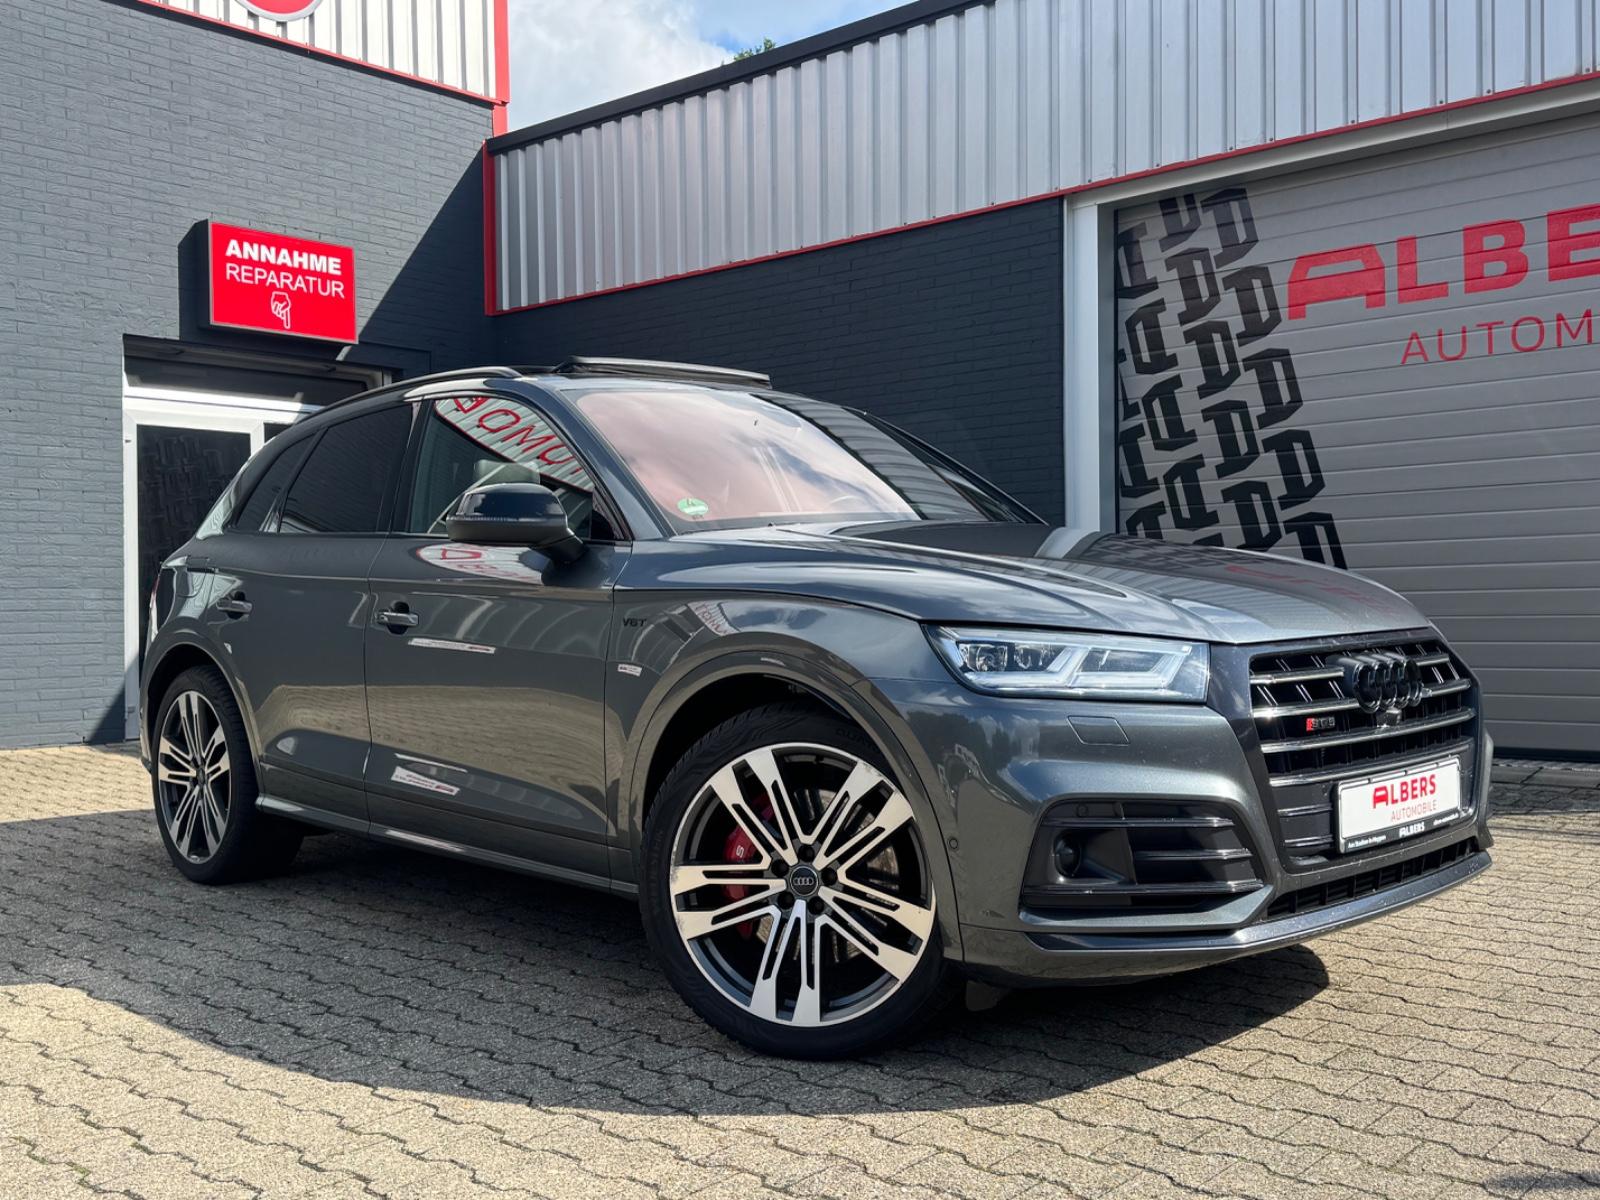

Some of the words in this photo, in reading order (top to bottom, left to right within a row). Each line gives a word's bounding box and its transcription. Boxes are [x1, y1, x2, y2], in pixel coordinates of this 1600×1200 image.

[225, 239, 342, 276] ANNAHME
[1287, 203, 1600, 321] ALBE
[225, 262, 345, 299] REPARATUR
[1372, 773, 1437, 810] ALBERS
[1391, 799, 1438, 823] AUTOMOBILE
[1398, 821, 1426, 838] ALBERS
